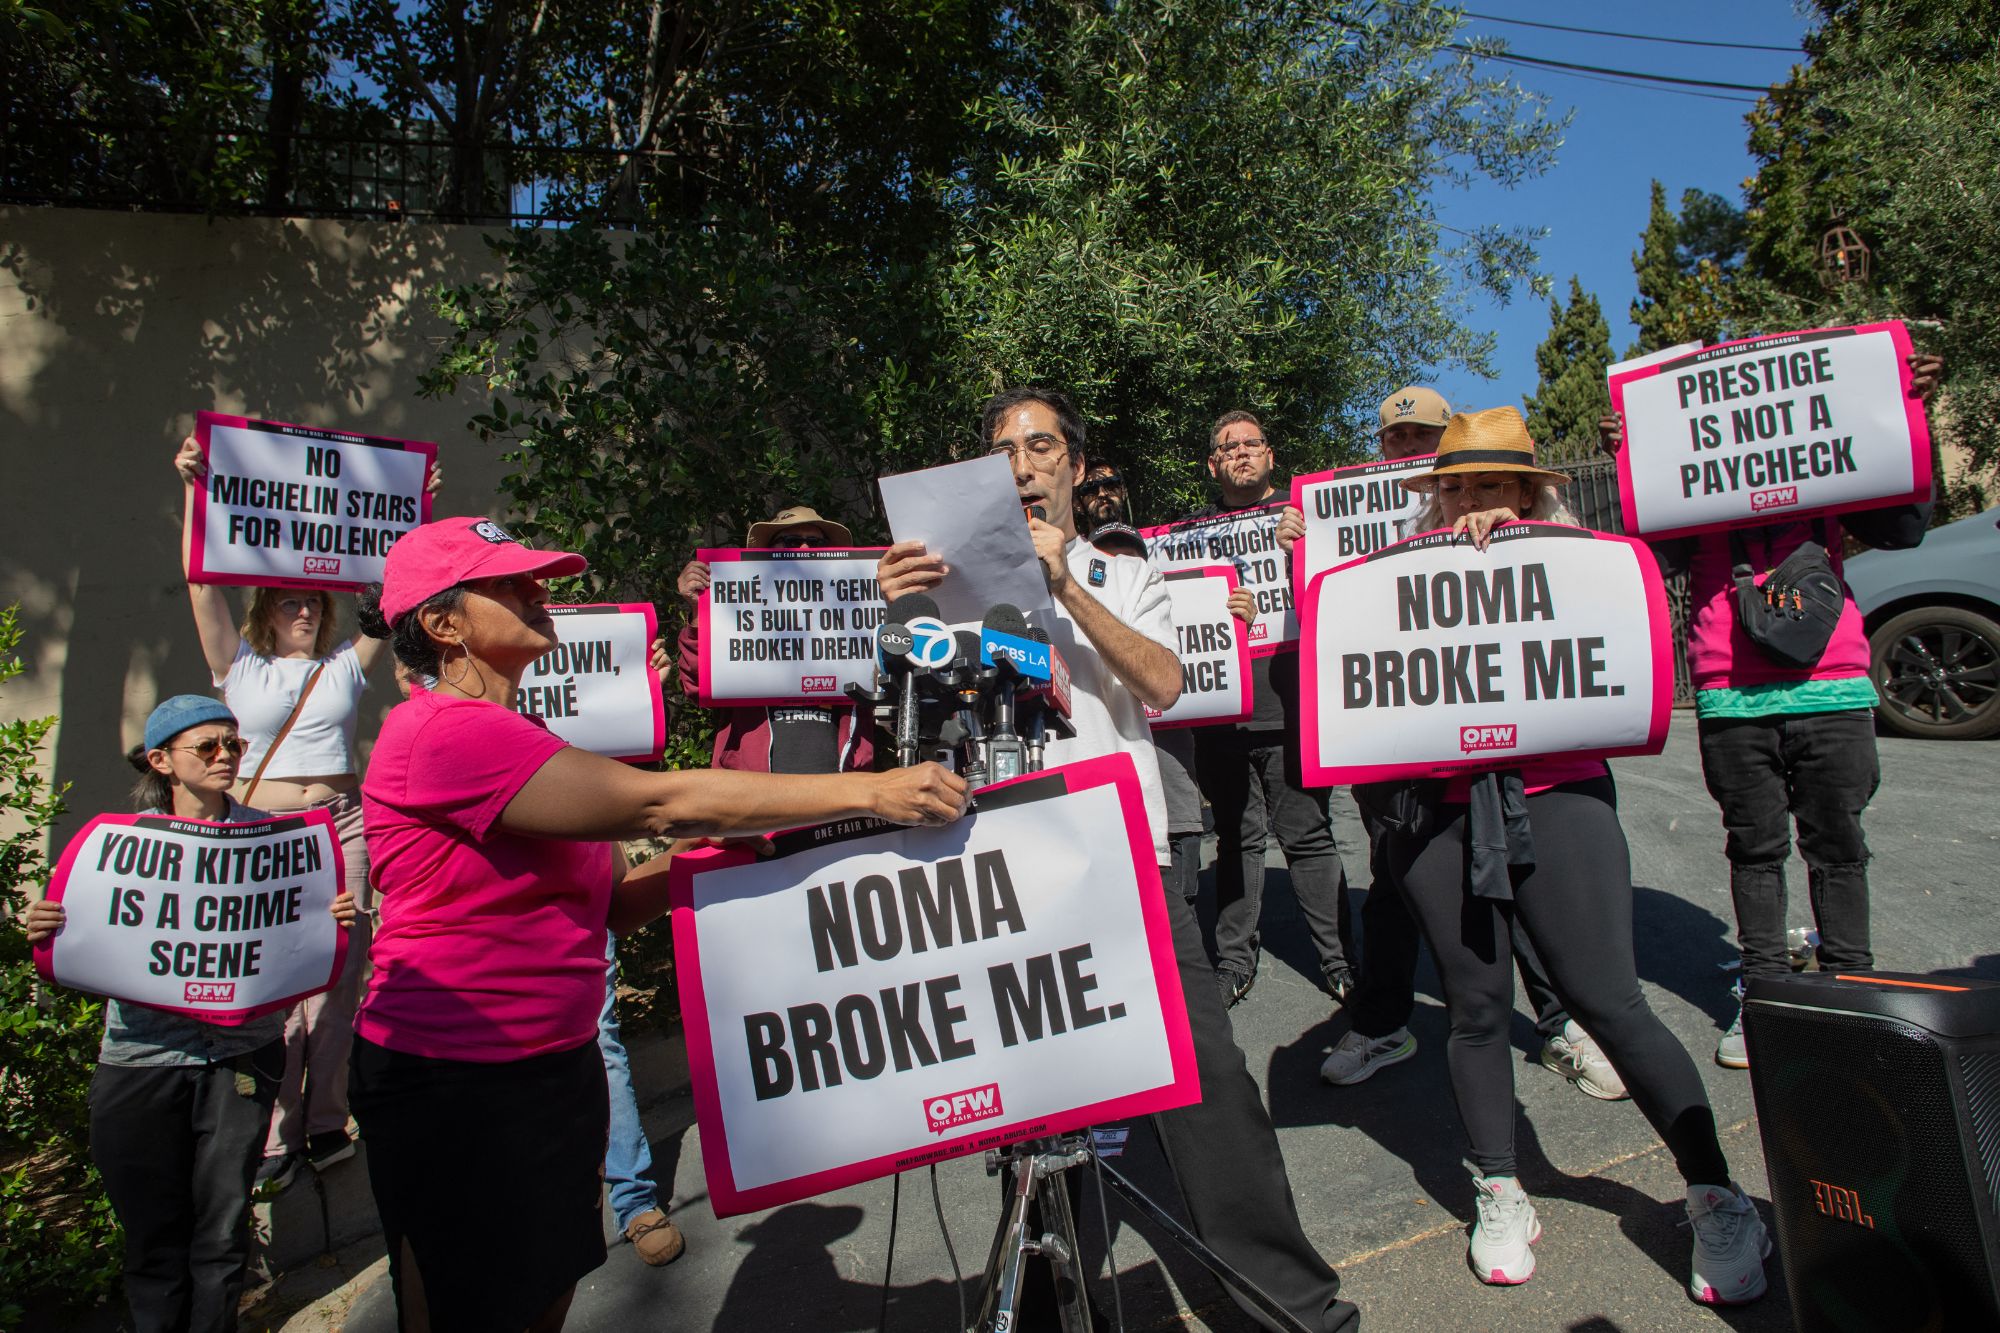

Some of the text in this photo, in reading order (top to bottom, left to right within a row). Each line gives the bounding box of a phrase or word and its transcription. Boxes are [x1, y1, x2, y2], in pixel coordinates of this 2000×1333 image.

[1711, 348, 1727, 357] FAIR
[1677, 347, 1834, 409] PRESTIGE
[1689, 394, 1833, 452] IS NOT A
[306, 446, 341, 479] NO
[1680, 436, 1858, 498] PAYCHECK
[212, 475, 416, 523] MICHELIN STARS
[1315, 478, 1409, 519] UNPAID
[1753, 488, 1794, 505] OFW
[228, 515, 280, 548] FOR
[1208, 527, 1277, 560] BOUGH
[1408, 539, 1423, 548] ONE
[1425, 535, 1443, 544] FAIR
[306, 558, 338, 570] OFW
[1251, 558, 1277, 584] TO
[714, 574, 768, 606] RENÉ,
[774, 580, 824, 602] YOUR
[1397, 562, 1555, 632] NOMA
[736, 610, 754, 632] IS
[761, 609, 813, 631] BUILT
[819, 608, 845, 631] ON
[534, 640, 620, 676] DOWN,
[729, 638, 805, 662] BROKEN
[881, 622, 956, 669] abc 7
[1029, 653, 1048, 668] LA
[803, 678, 834, 688] OFW
[1342, 636, 1625, 710] BROKE ME.
[516, 676, 578, 718] RENÉ
[774, 709, 832, 723] STRIKE!
[1463, 727, 1513, 743] OFW
[183, 823, 198, 832] FAIR
[200, 826, 220, 835] WAGE
[814, 817, 894, 840] ONE FAIR WAG
[96, 832, 322, 885] YOUR KITCHEN
[108, 886, 302, 932] IS A CRIME
[806, 849, 1027, 973] NOMA
[149, 940, 262, 979] SCENE
[187, 984, 233, 996] OFW
[743, 942, 1128, 1102] BROKE ME.
[929, 1088, 994, 1121] OFW
[932, 1107, 999, 1128] ONE FAIR WAGE
[1810, 1179, 1874, 1229] JBL
